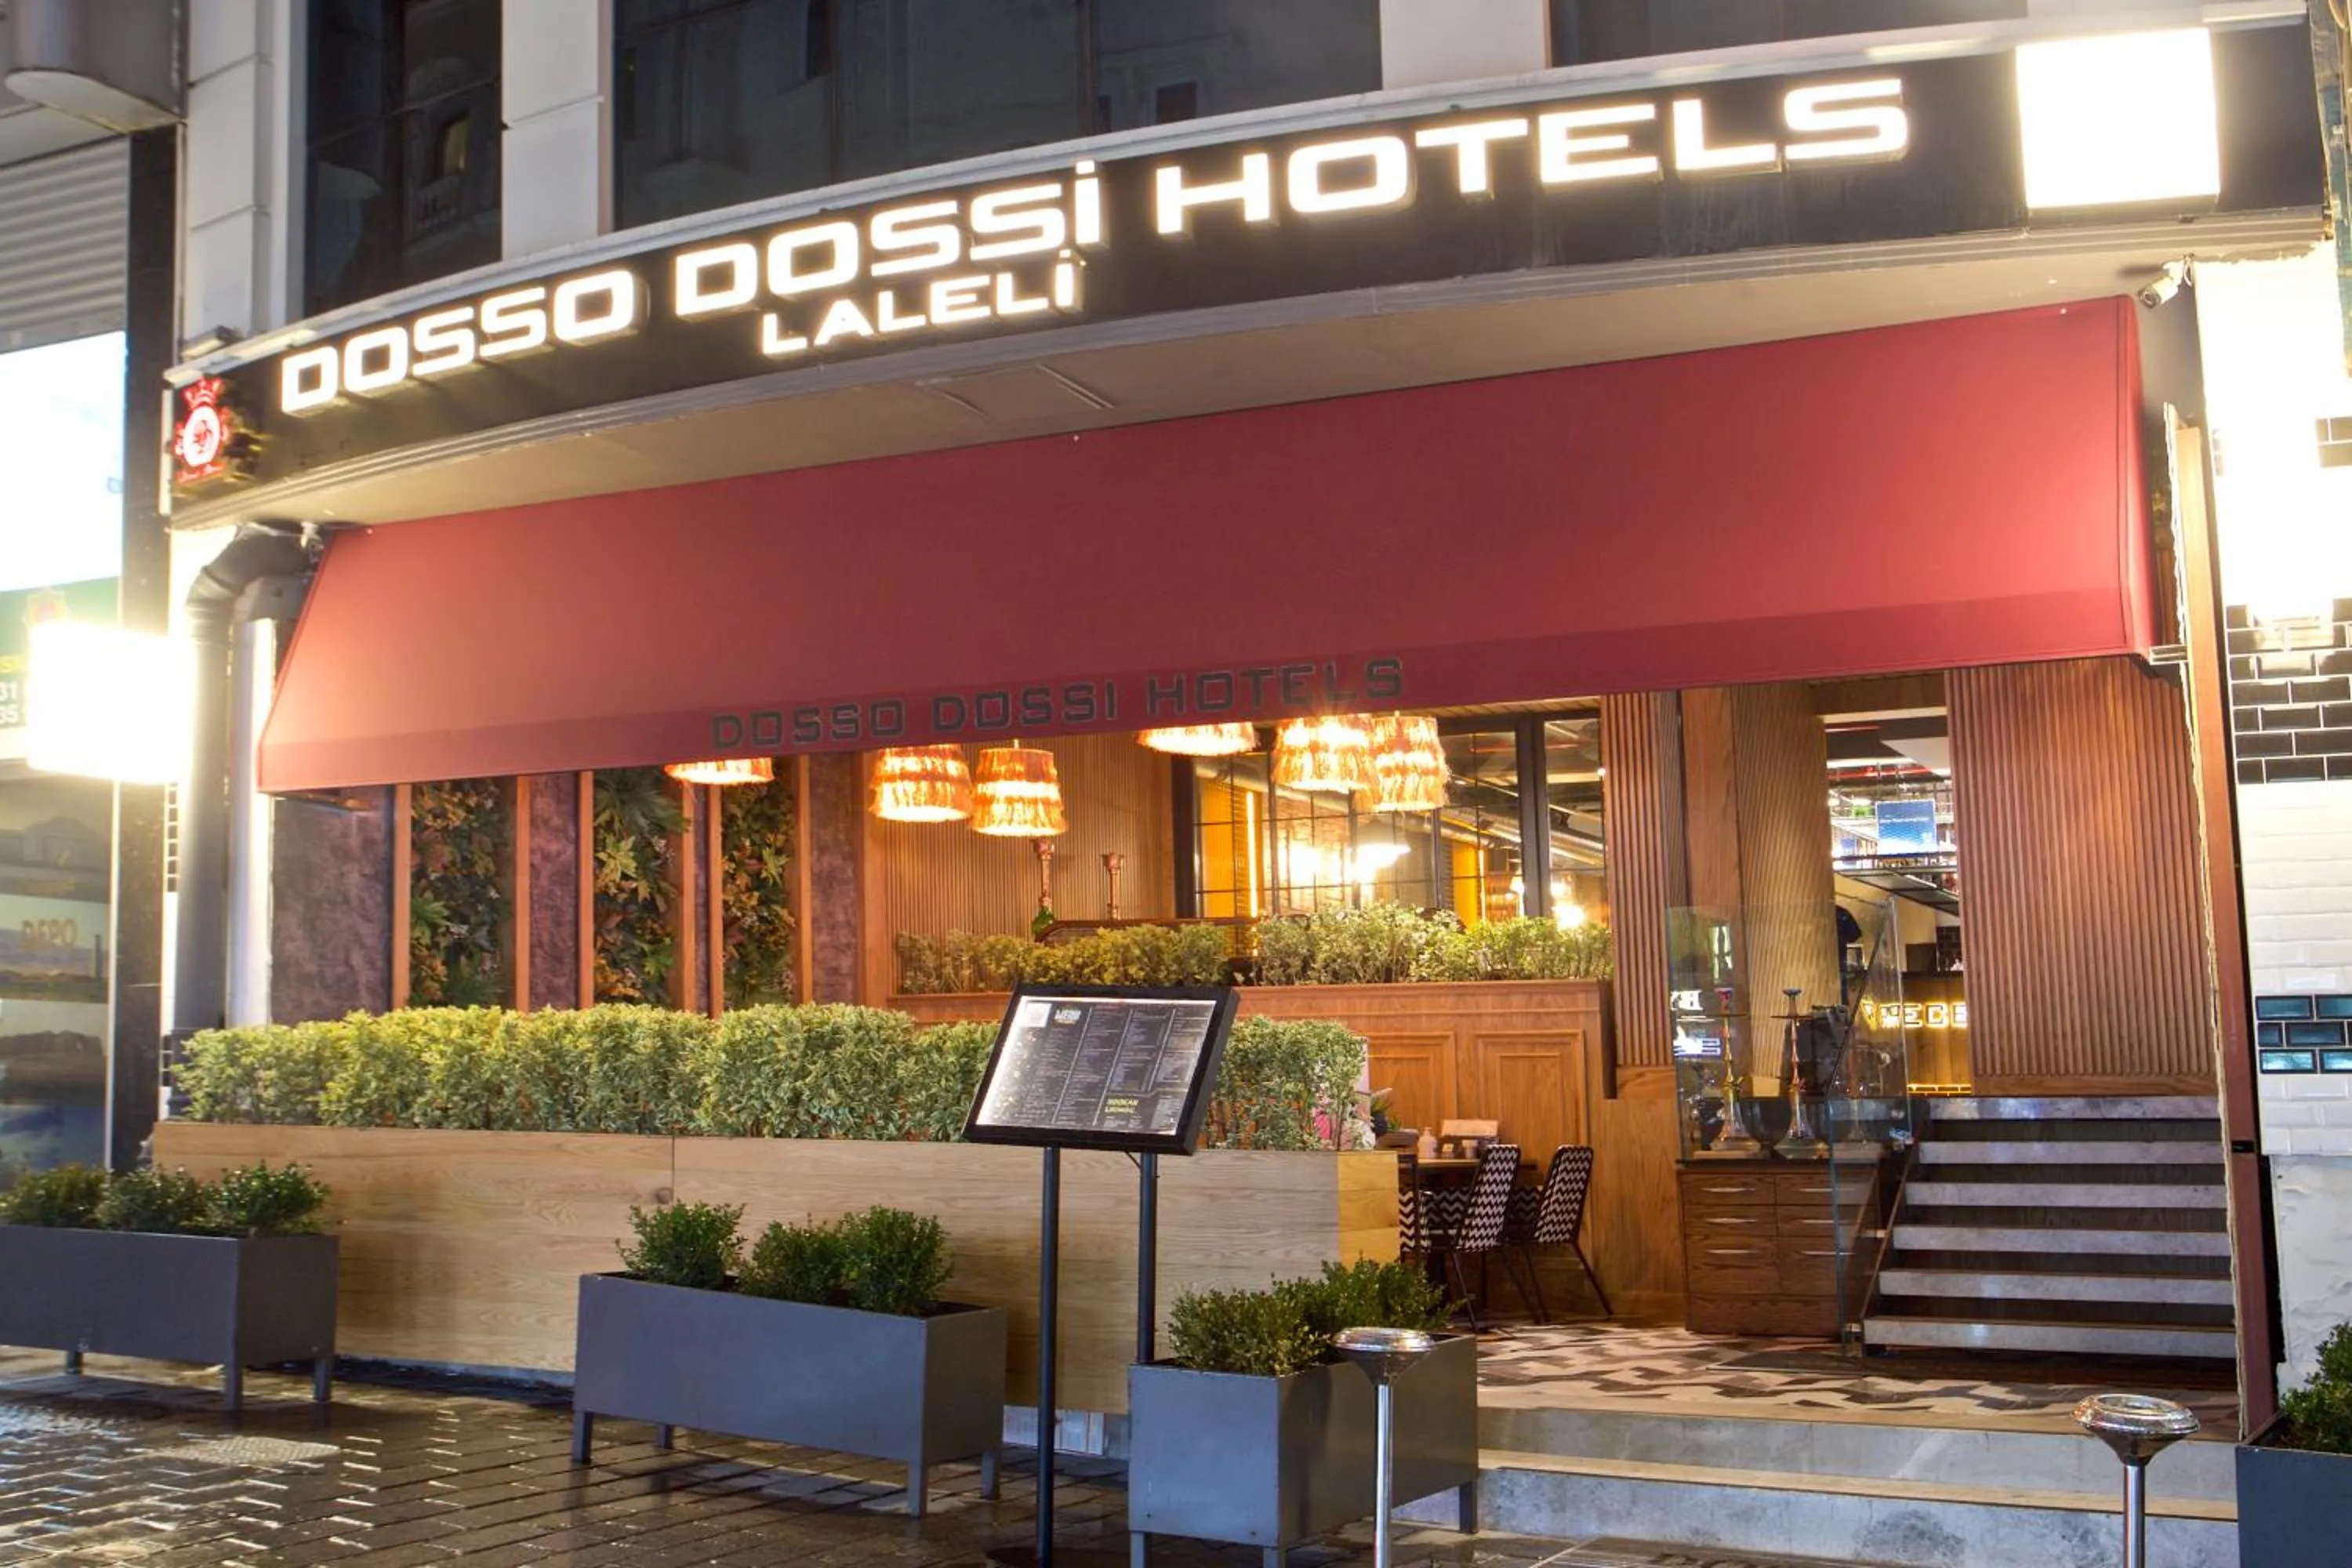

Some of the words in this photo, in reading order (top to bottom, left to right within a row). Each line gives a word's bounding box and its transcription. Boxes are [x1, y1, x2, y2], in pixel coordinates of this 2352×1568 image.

[281, 269, 636, 414] DOSSO
[1156, 78, 1909, 236] HOTELS
[711, 698, 906, 750] DOSSO
[932, 679, 1117, 734] DOSSI
[1146, 657, 1403, 717] HOTELS
